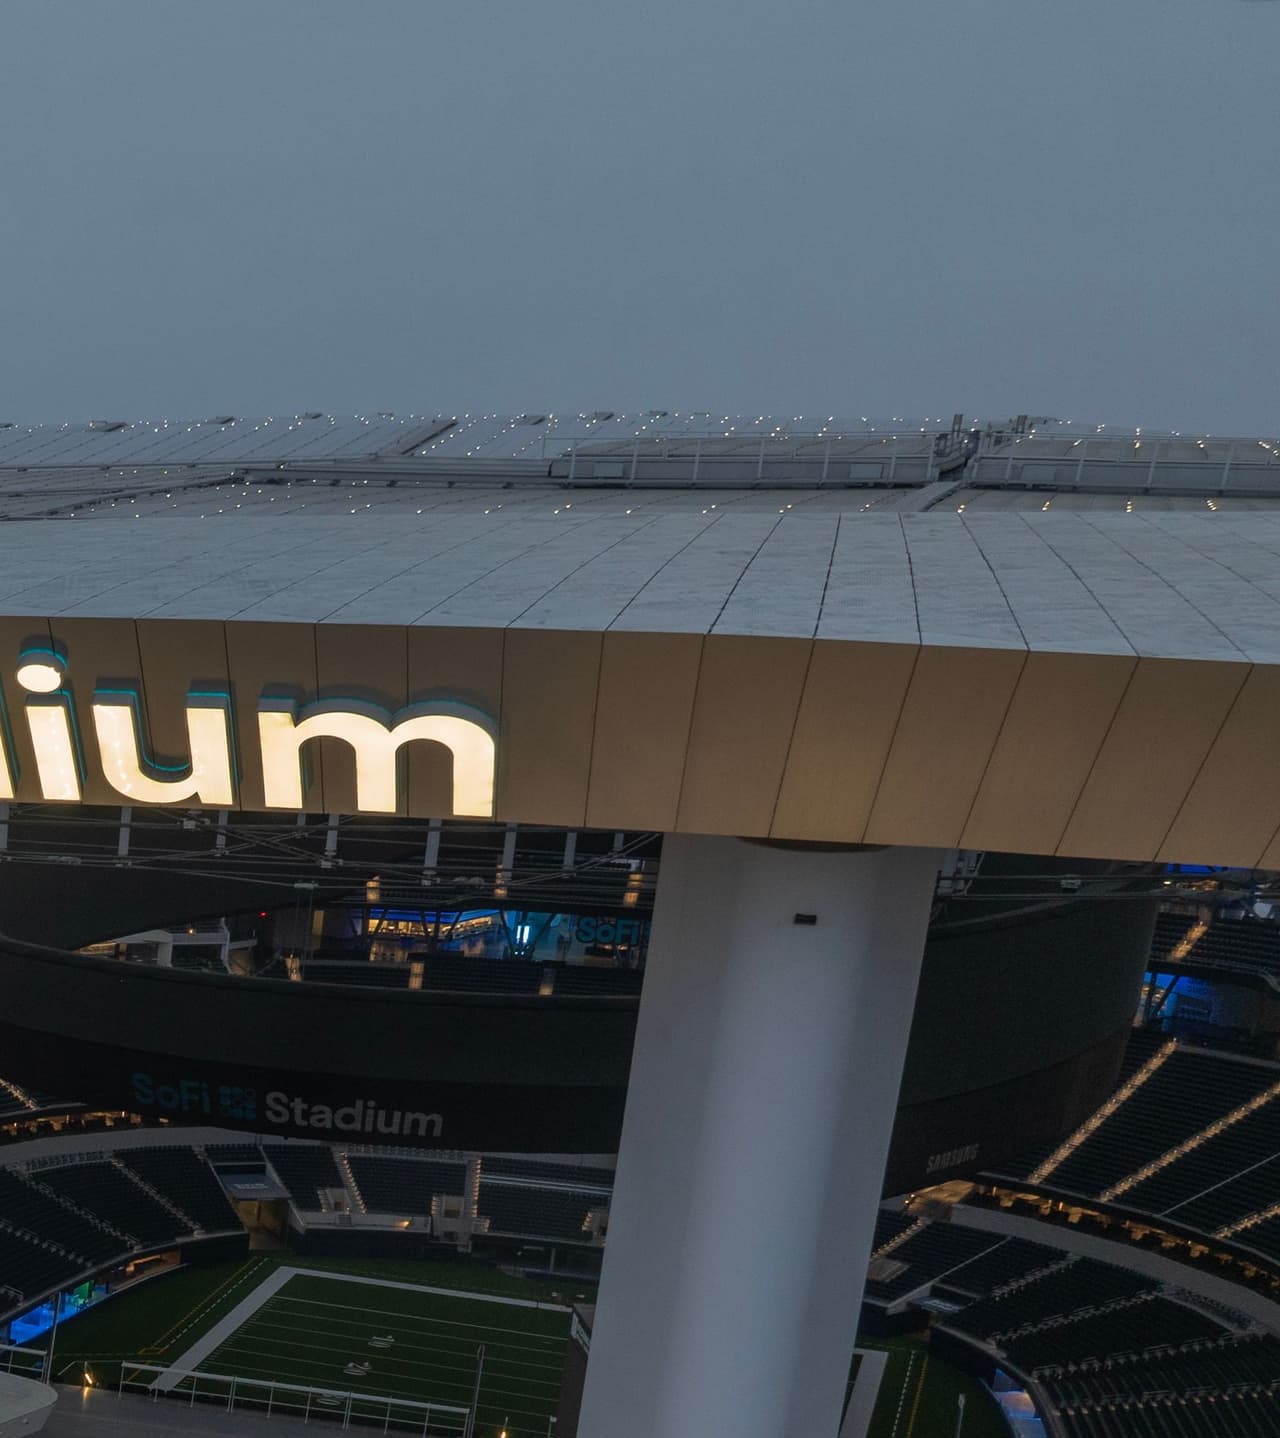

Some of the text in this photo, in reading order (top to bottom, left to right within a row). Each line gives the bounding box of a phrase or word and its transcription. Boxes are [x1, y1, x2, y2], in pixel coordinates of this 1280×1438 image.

[576, 916, 641, 946] SoFi
[131, 1071, 444, 1138] SoFi Stadium
